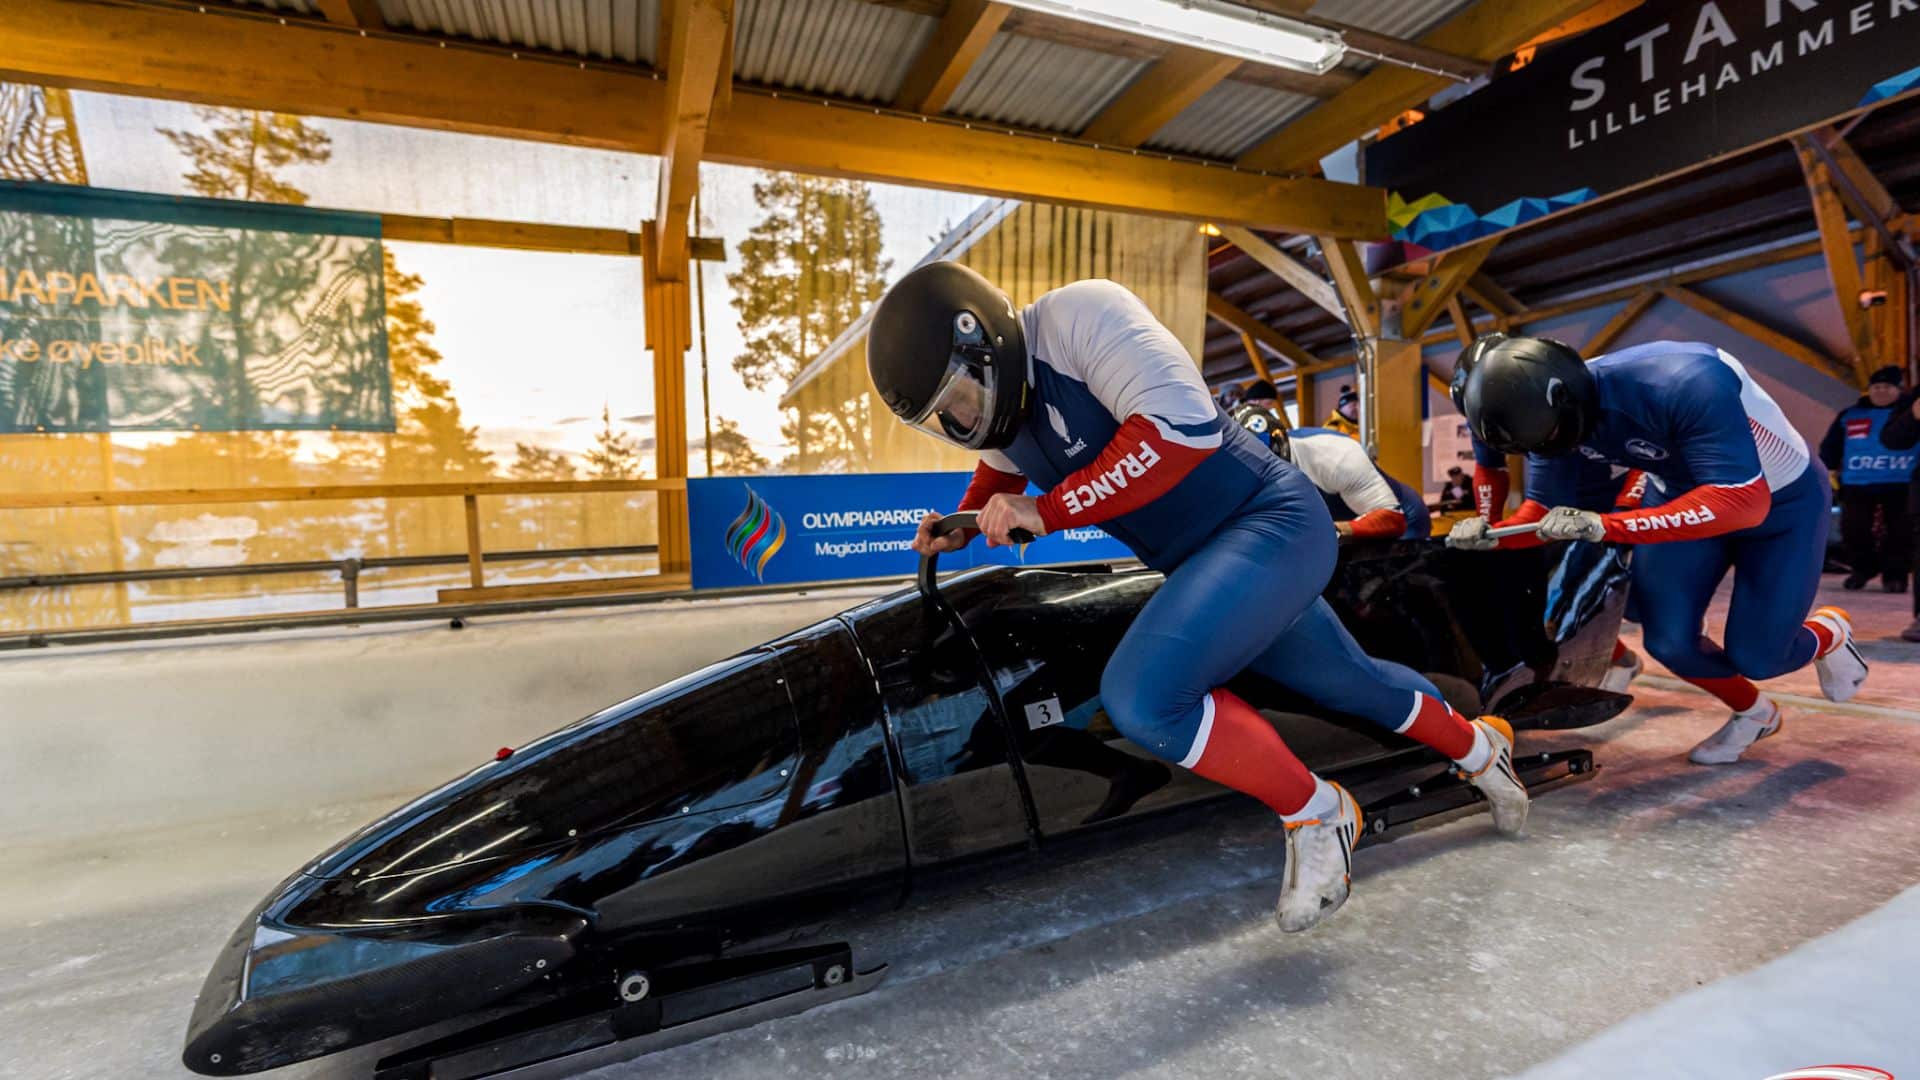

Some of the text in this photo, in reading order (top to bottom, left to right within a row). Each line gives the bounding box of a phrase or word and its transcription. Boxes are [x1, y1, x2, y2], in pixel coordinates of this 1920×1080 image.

[47, 334, 202, 370] øyeblikk
[1847, 455, 1915, 470] CREW
[1062, 440, 1161, 515] FRANCE
[802, 508, 935, 529] OLYMPIAPARKE
[1623, 504, 1717, 532] FRANCE
[815, 541, 867, 558] Magical
[1038, 704, 1052, 724] 3
